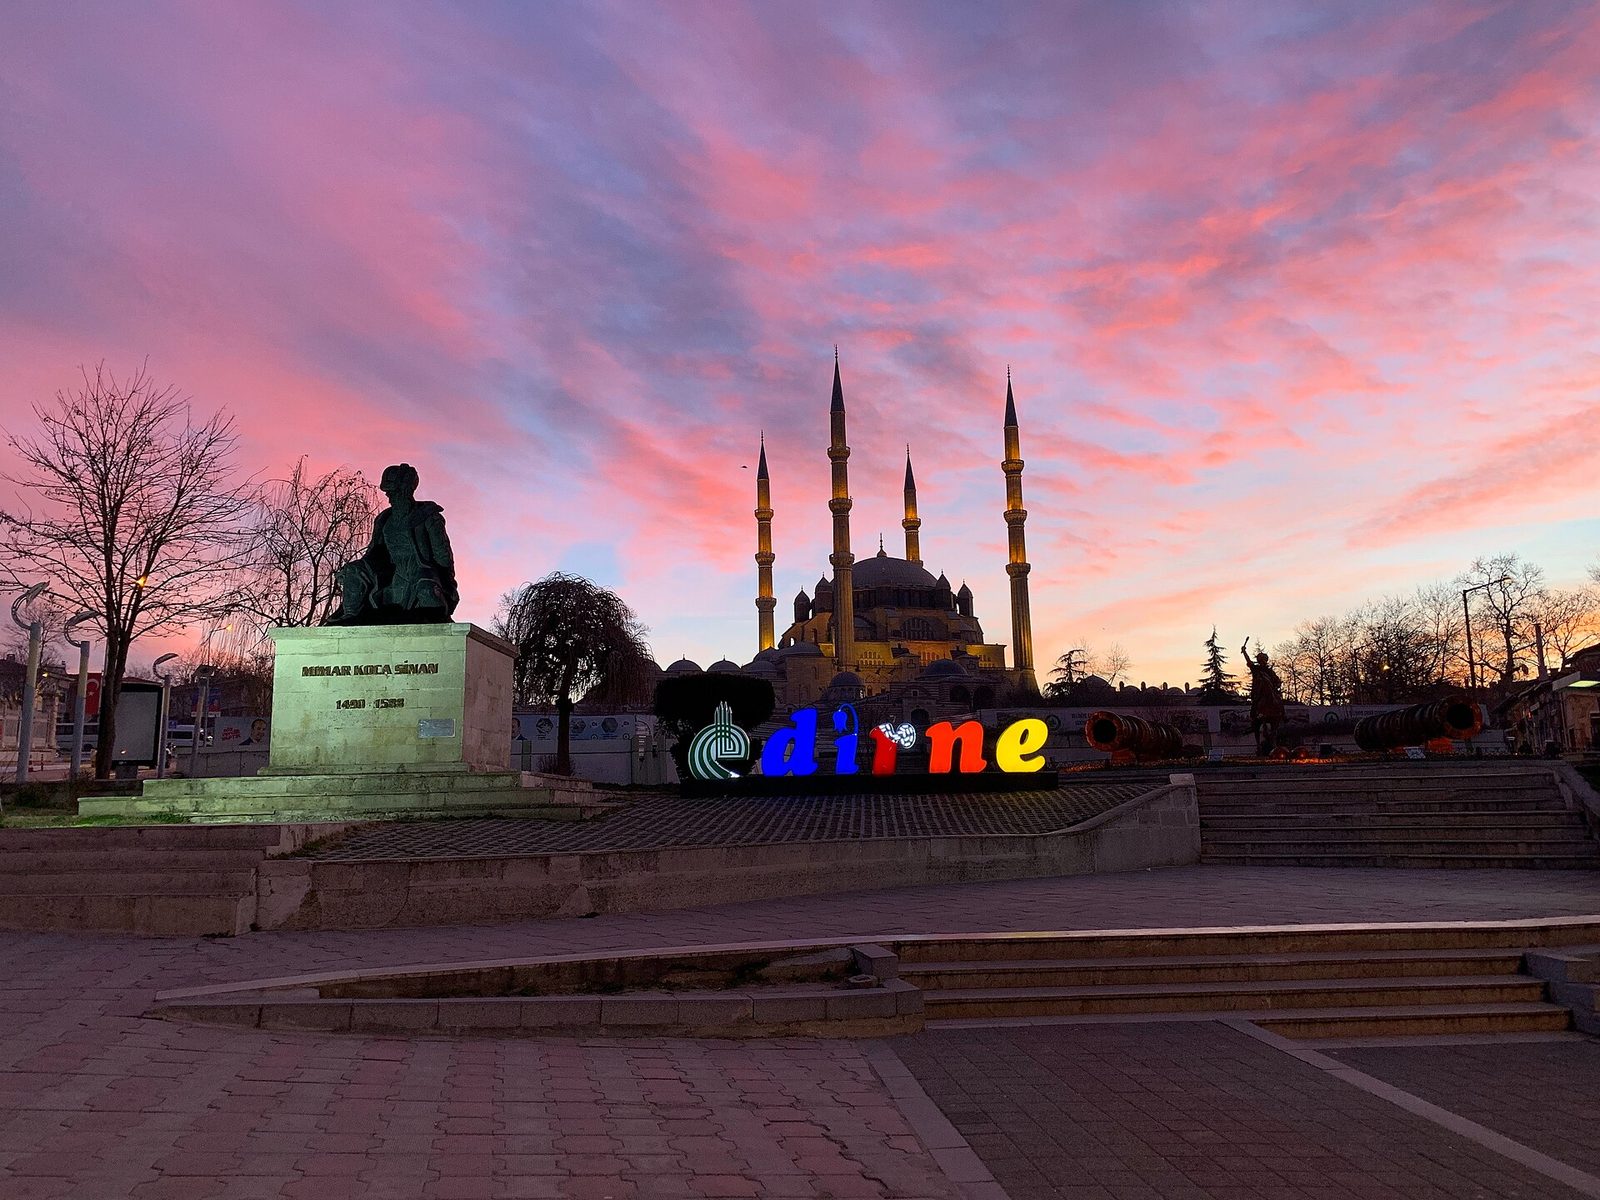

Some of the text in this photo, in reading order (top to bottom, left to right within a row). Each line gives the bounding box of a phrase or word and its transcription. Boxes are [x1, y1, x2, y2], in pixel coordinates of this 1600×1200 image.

[302, 660, 439, 677] MIMAR KOCA SİNAN
